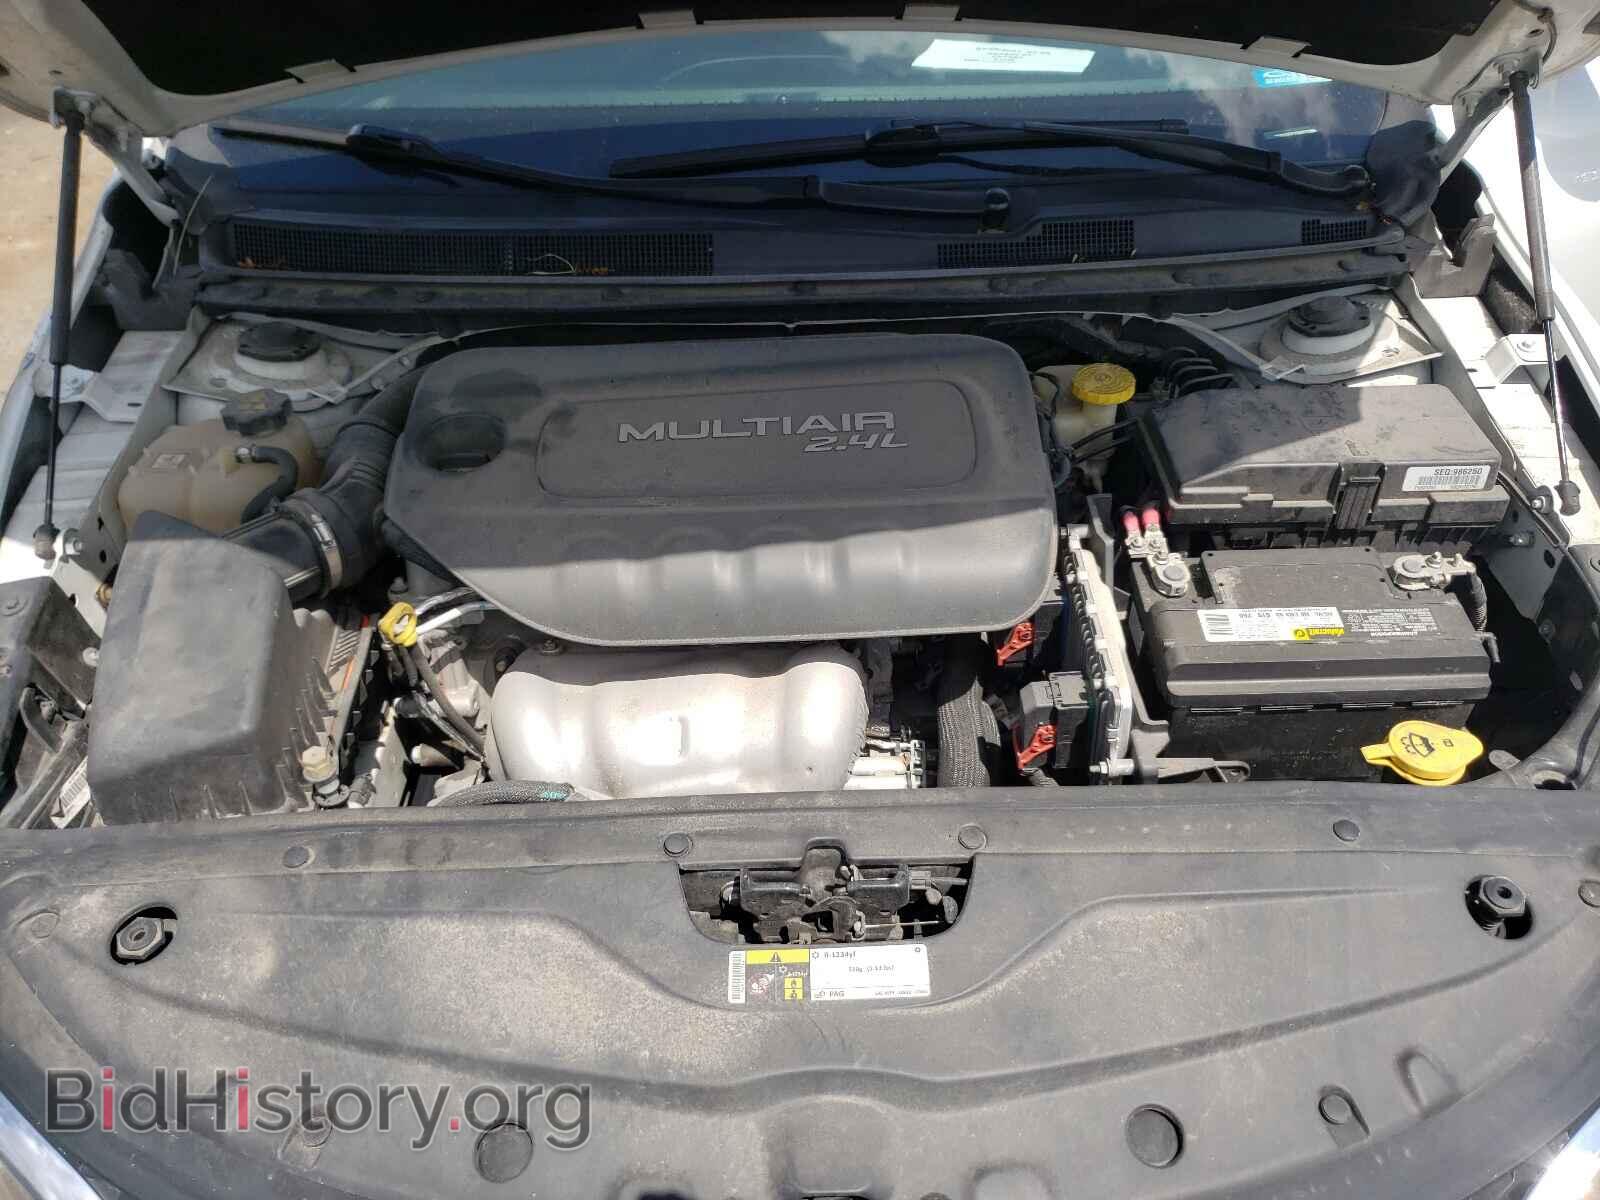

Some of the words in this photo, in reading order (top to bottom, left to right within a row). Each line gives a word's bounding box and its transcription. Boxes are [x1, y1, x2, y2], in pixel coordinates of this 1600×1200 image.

[617, 411, 896, 443] MULTIAIR
[803, 432, 909, 453] 2.4L
[829, 990, 846, 998] PAG
